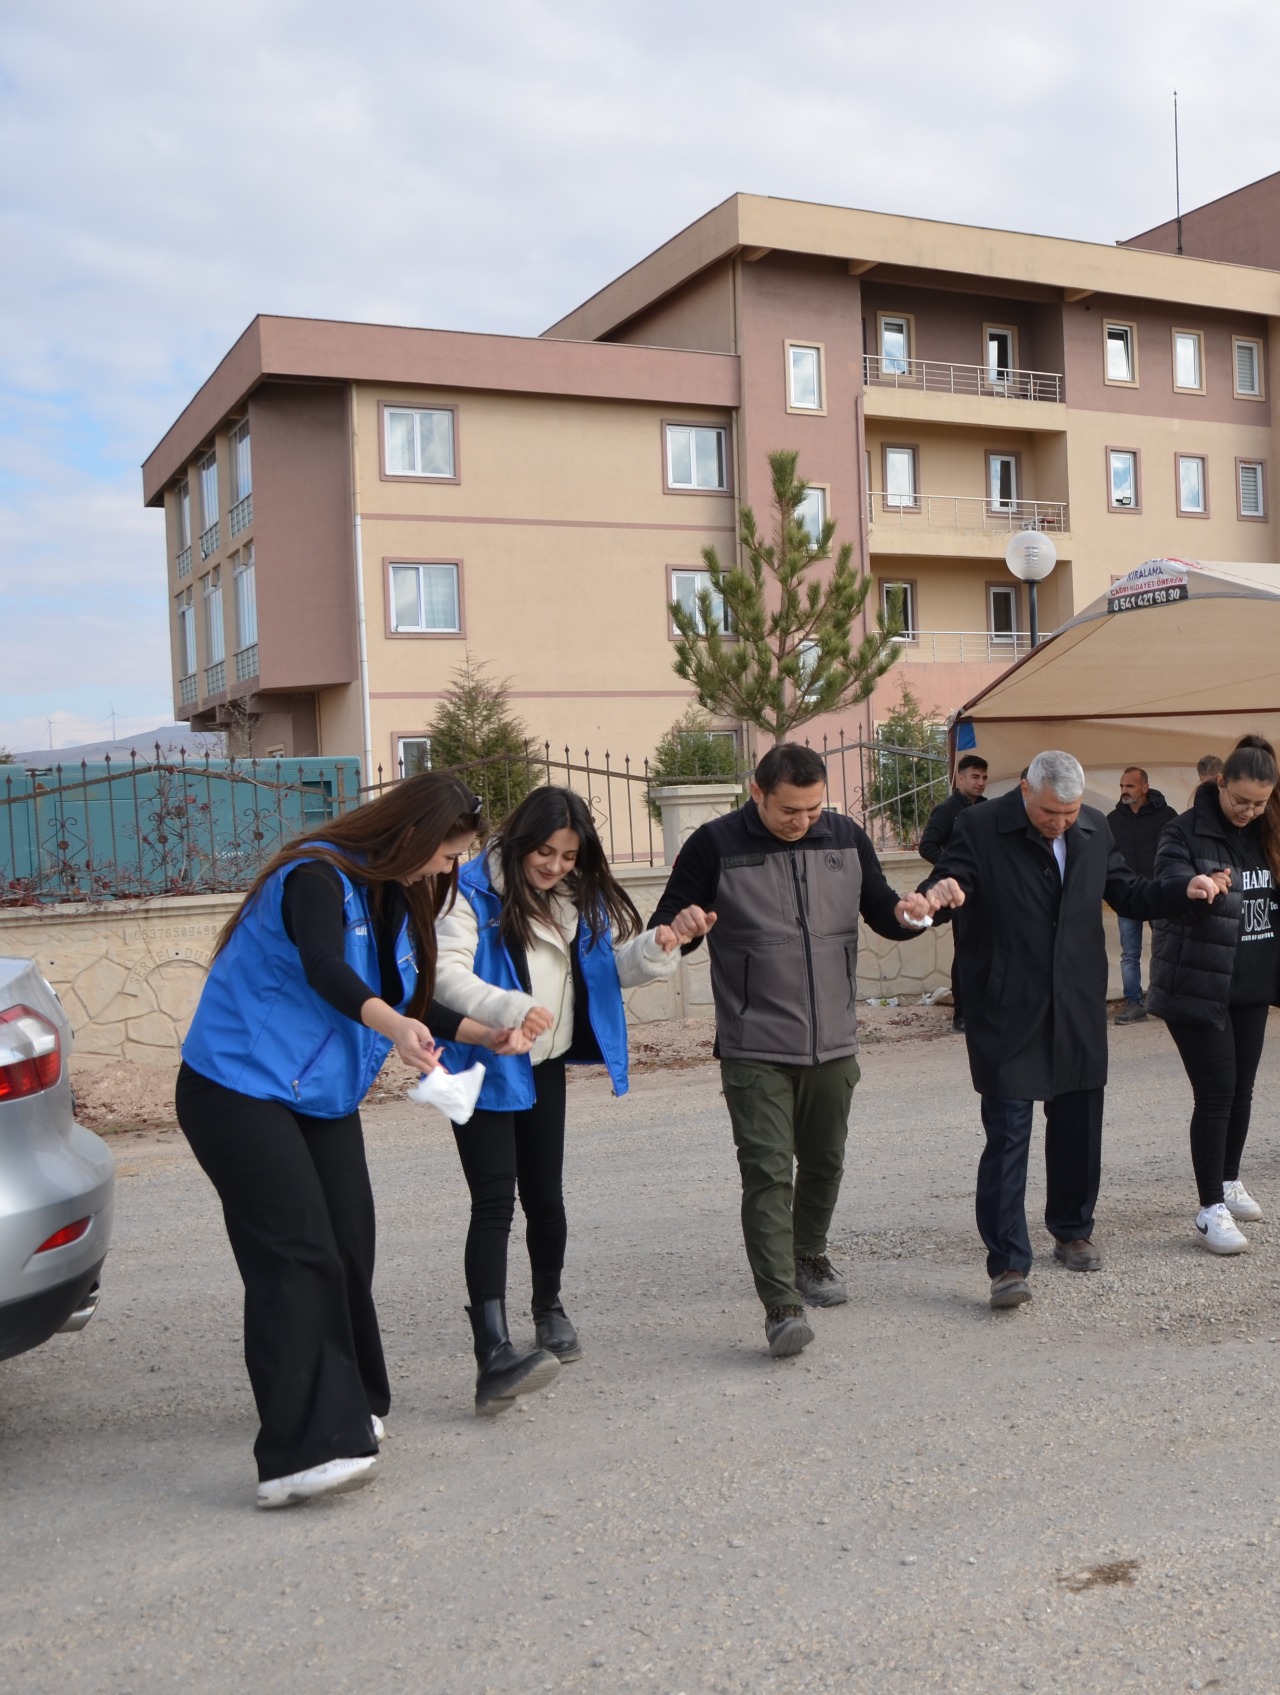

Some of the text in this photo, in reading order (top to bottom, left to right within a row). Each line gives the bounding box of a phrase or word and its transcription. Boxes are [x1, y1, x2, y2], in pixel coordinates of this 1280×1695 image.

[1113, 589, 1180, 611] 0 541 427 50 30
[1243, 897, 1272, 933] USA
